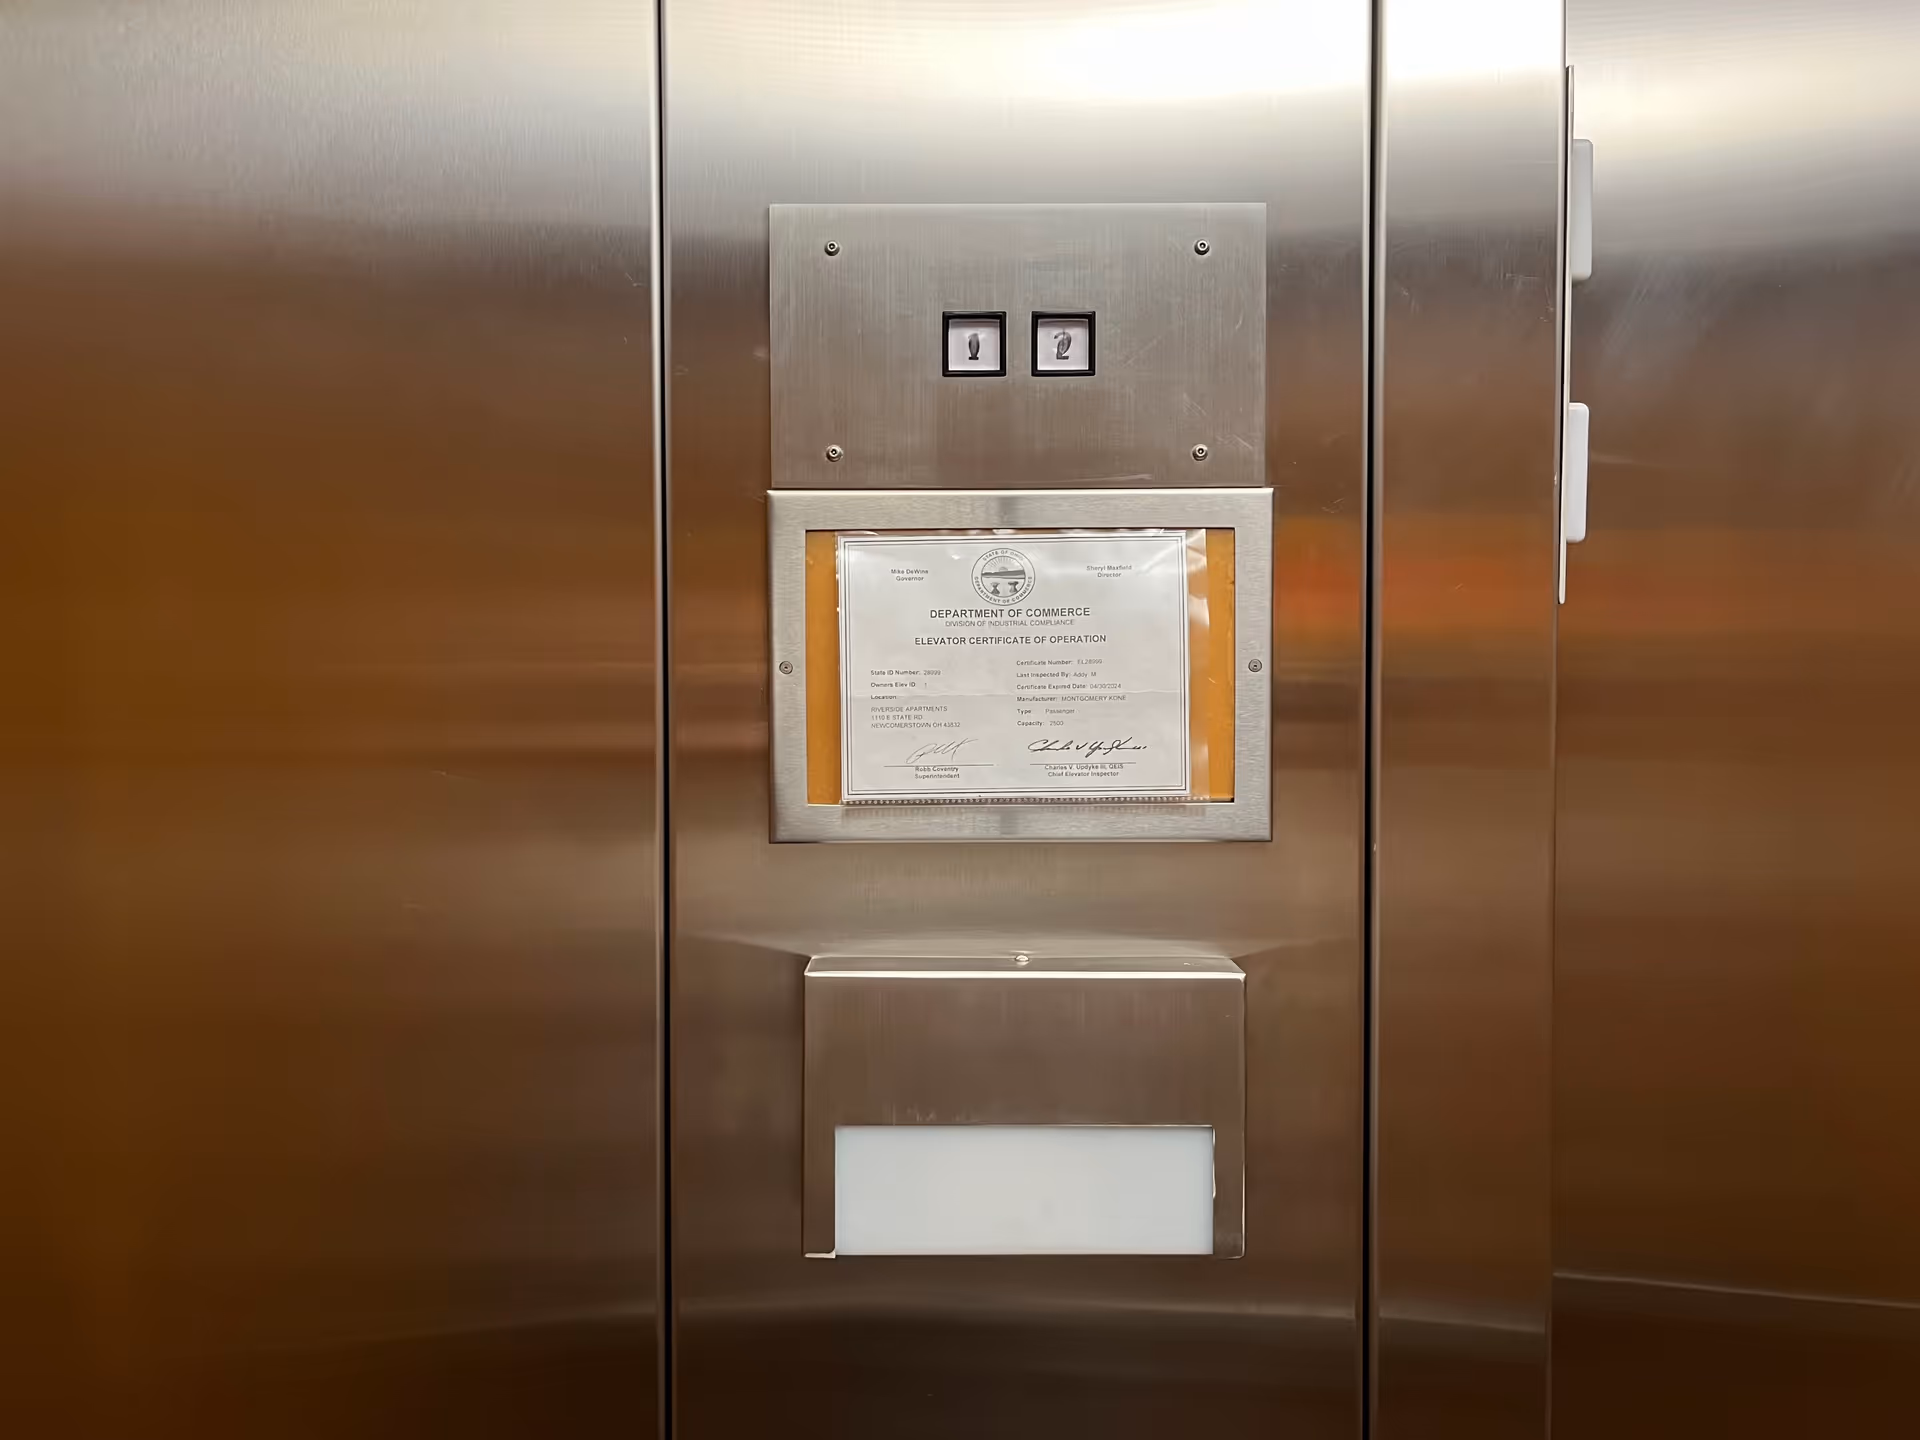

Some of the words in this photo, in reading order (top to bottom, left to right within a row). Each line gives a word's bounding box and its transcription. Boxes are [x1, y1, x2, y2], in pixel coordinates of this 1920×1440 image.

[1053, 331, 1072, 360] 2
[930, 609, 1004, 618] DEPARTMENT
[1008, 609, 1023, 618] OF
[1026, 607, 1090, 617] COMMERCE
[914, 637, 966, 646] ELEVATOR
[969, 636, 1031, 645] CERTIFICATE
[1034, 636, 1047, 644] OF
[1049, 634, 1107, 644] OPERATION
[1076, 764, 1098, 772] Updyke
